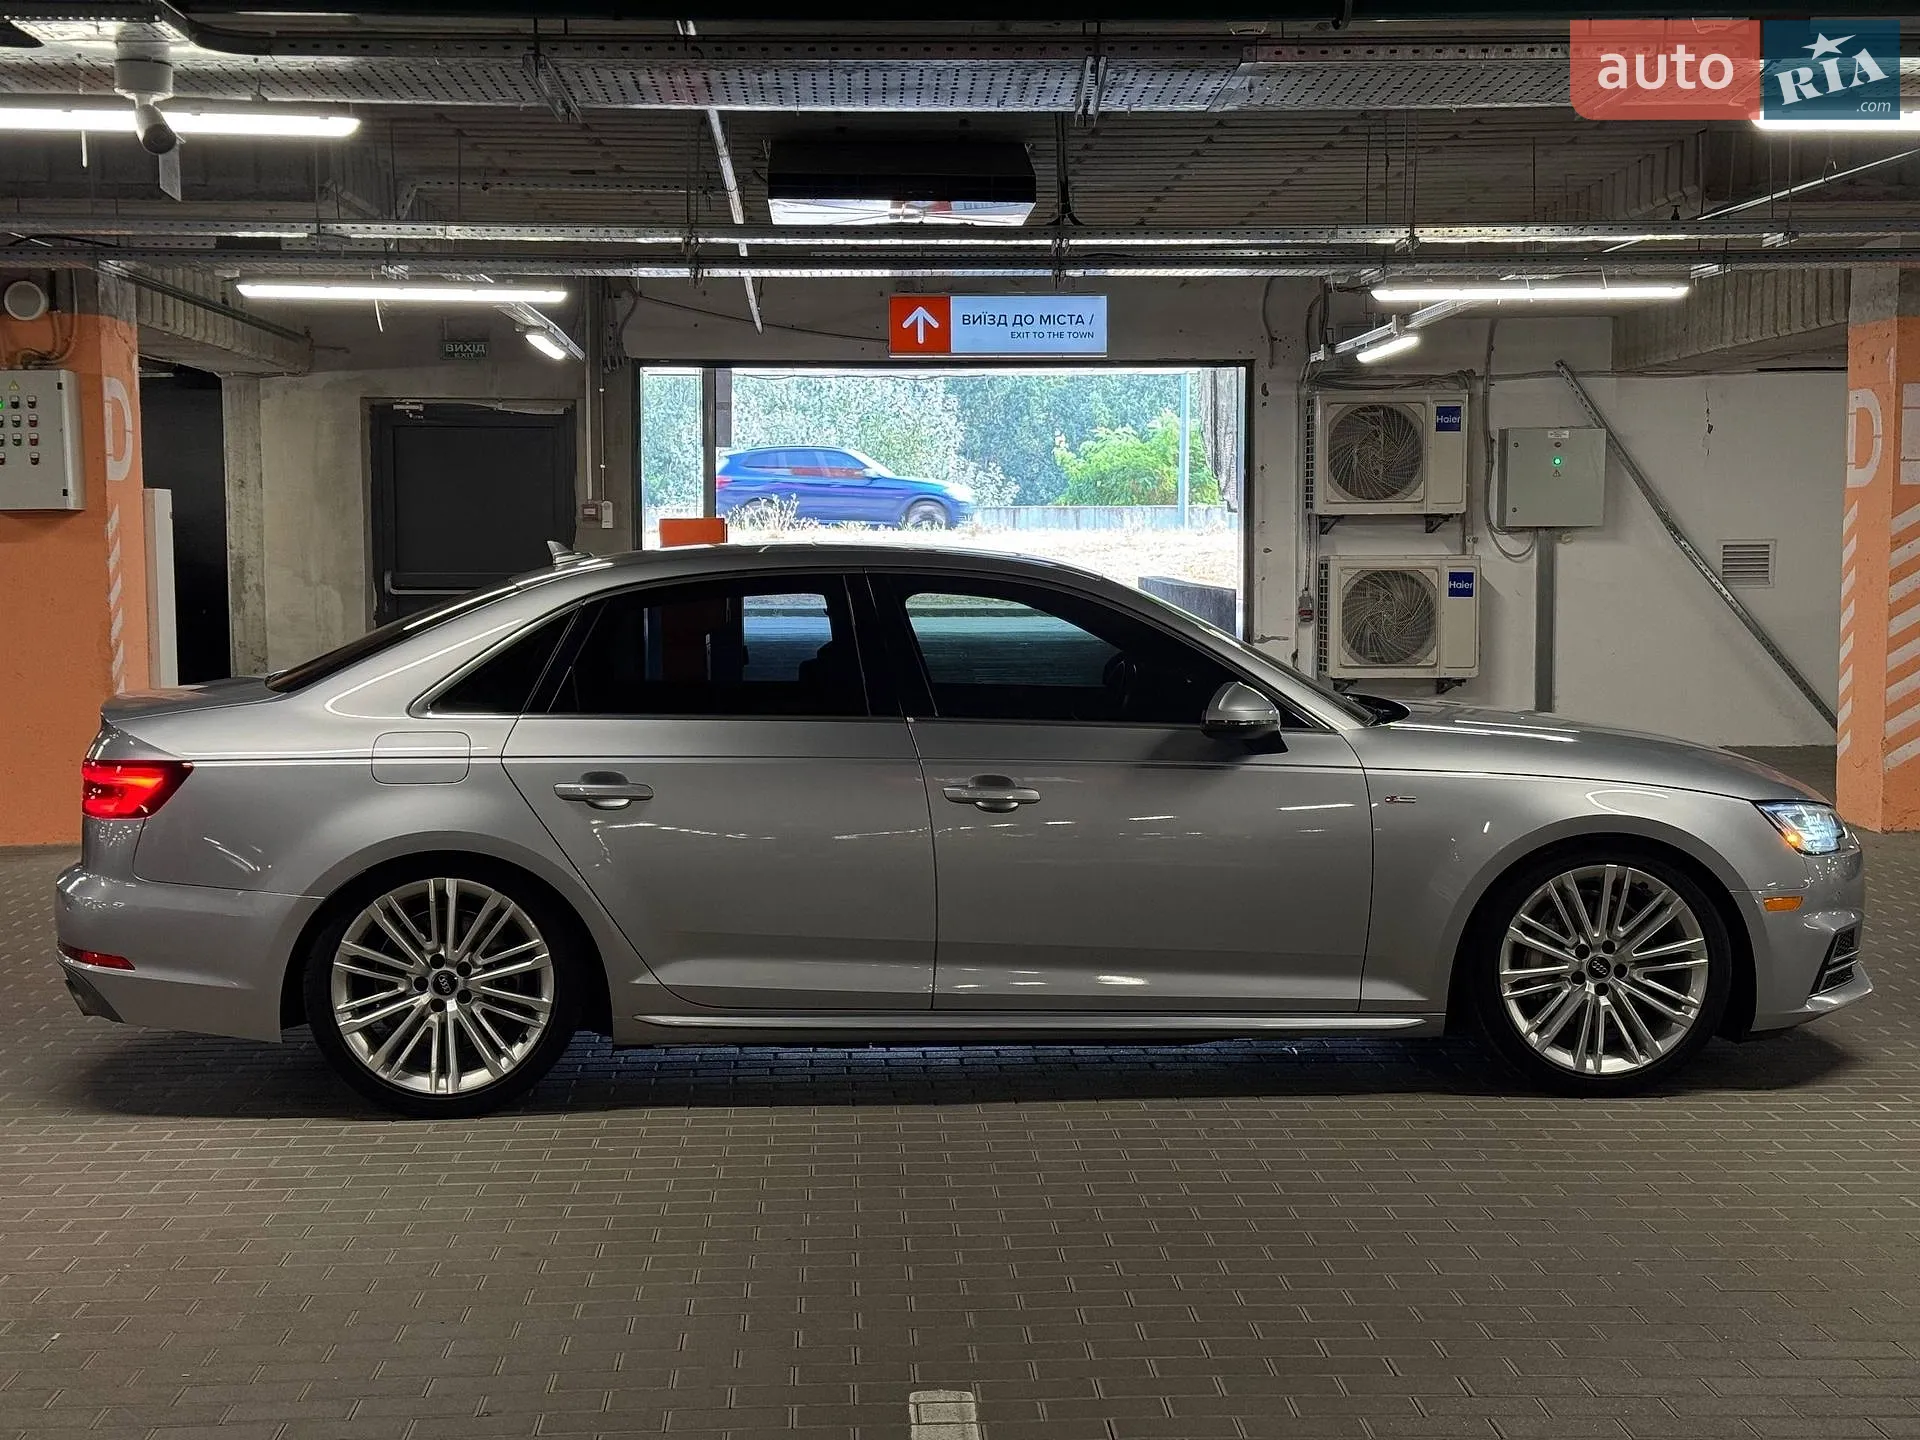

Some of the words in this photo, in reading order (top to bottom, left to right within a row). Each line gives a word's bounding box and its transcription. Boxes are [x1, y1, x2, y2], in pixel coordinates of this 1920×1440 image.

[962, 311, 1008, 327] ВИЇЗД
[1012, 314, 1035, 327] ДО
[1039, 314, 1085, 326] МІСТА
[1010, 331, 1030, 339] EXIT
[1032, 331, 1045, 339] TO
[1046, 331, 1065, 339] THE
[1067, 331, 1095, 339] TOWN
[445, 343, 486, 354] ВИХІД
[1436, 415, 1461, 424] Haier
[103, 376, 133, 481] D
[1846, 388, 1883, 489] D
[1449, 580, 1473, 589] Haier
